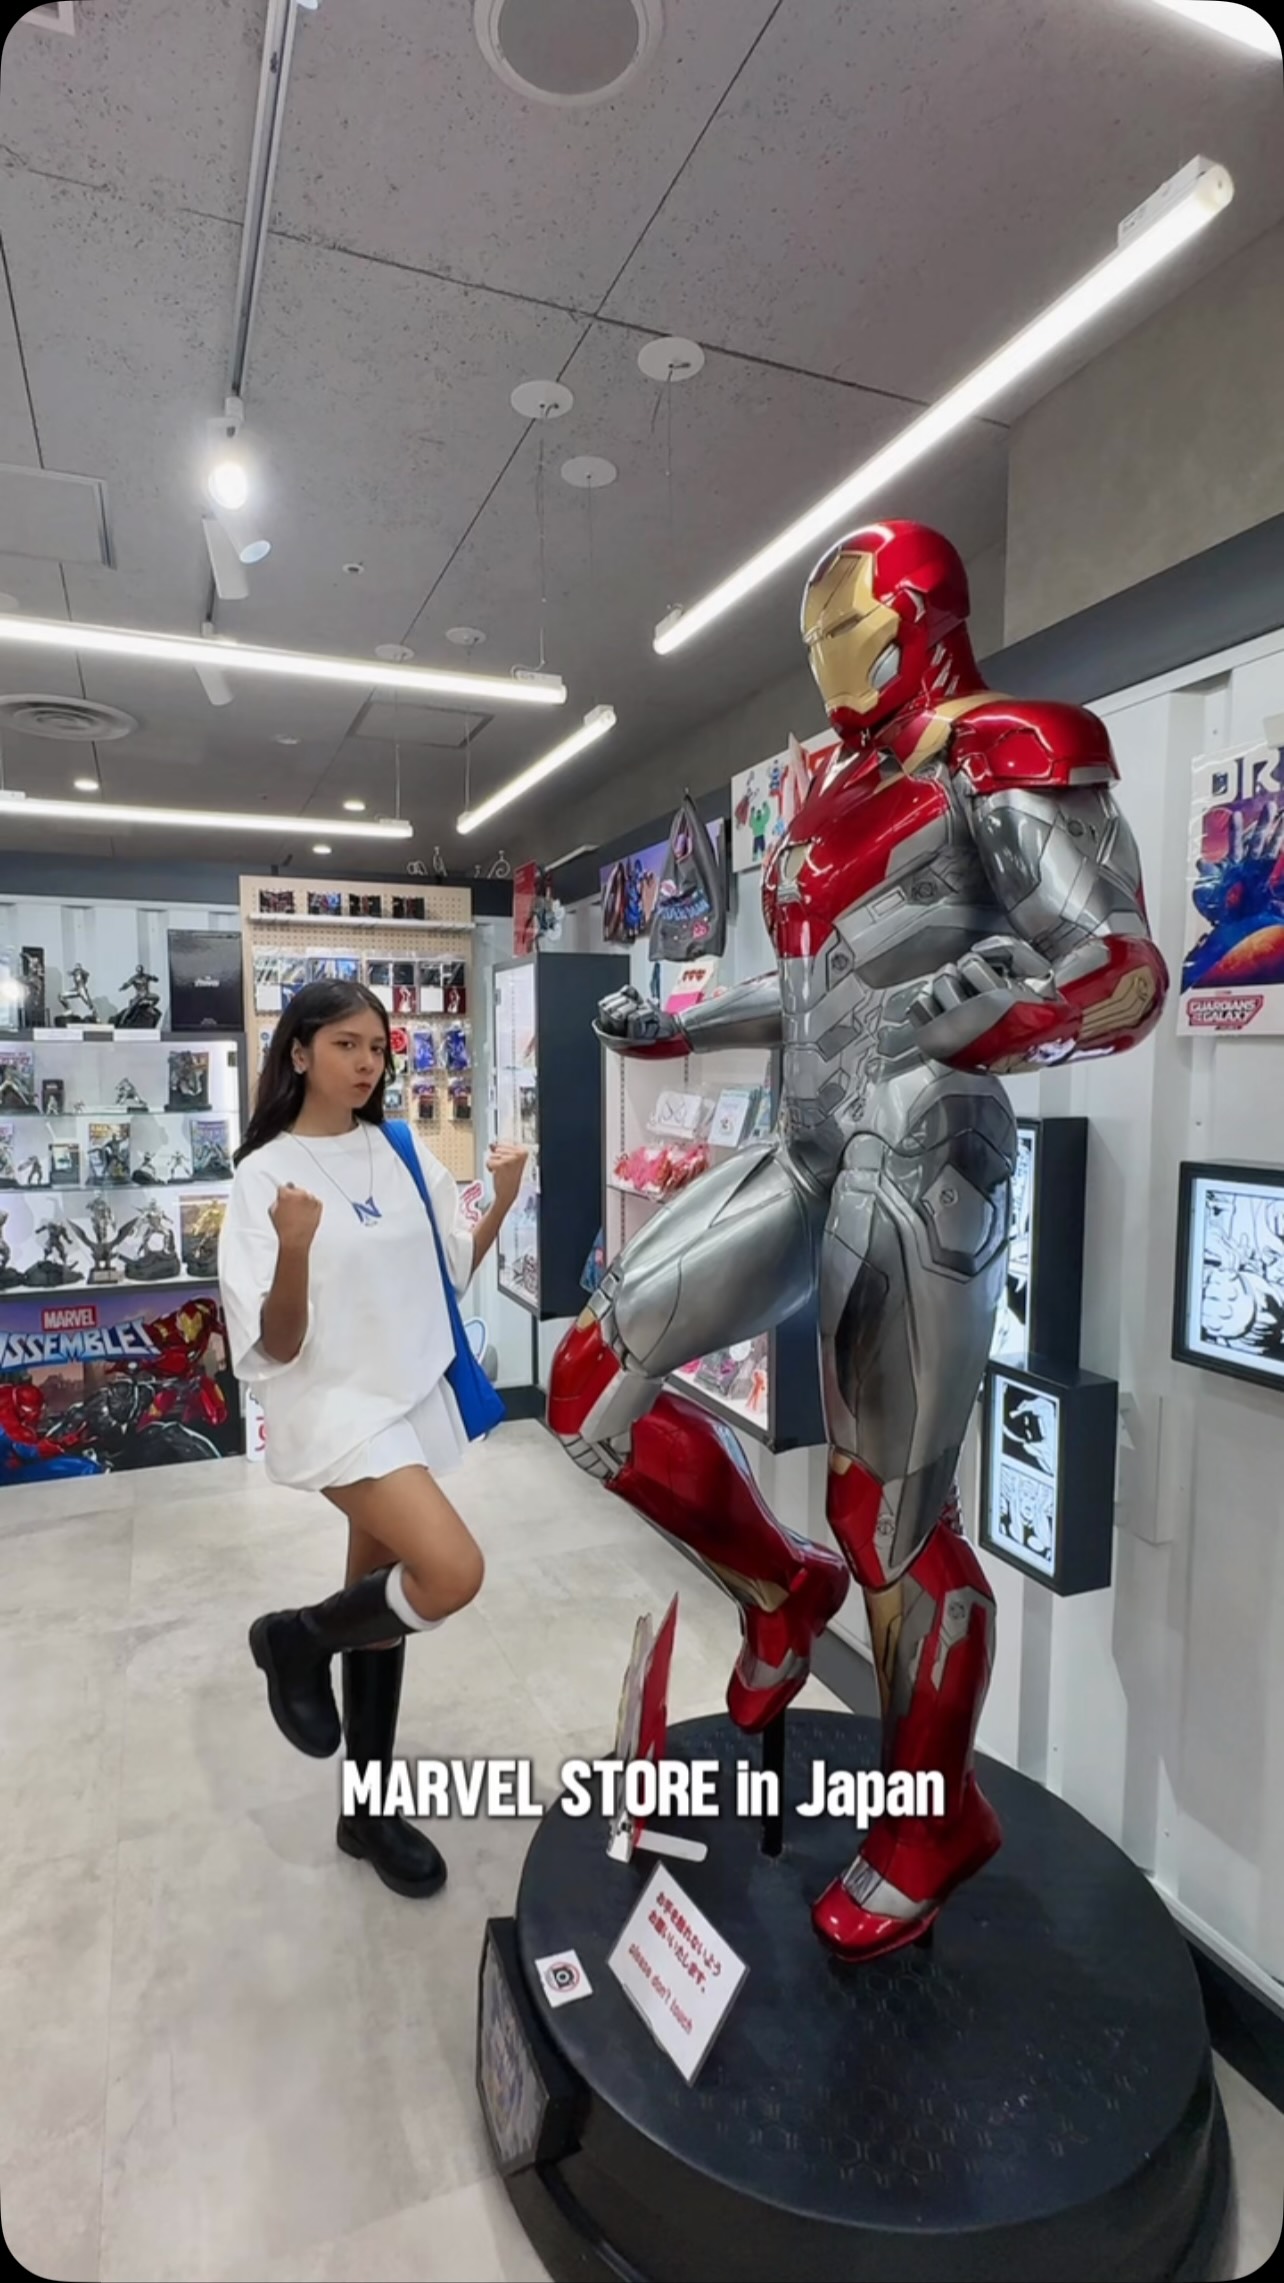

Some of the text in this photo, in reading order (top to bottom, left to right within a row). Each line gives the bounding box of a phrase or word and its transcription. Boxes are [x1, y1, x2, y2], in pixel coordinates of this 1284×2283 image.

[44, 1308, 96, 1329] MARVEL
[628, 1943, 652, 1979] please
[669, 1999, 693, 2035] touch
